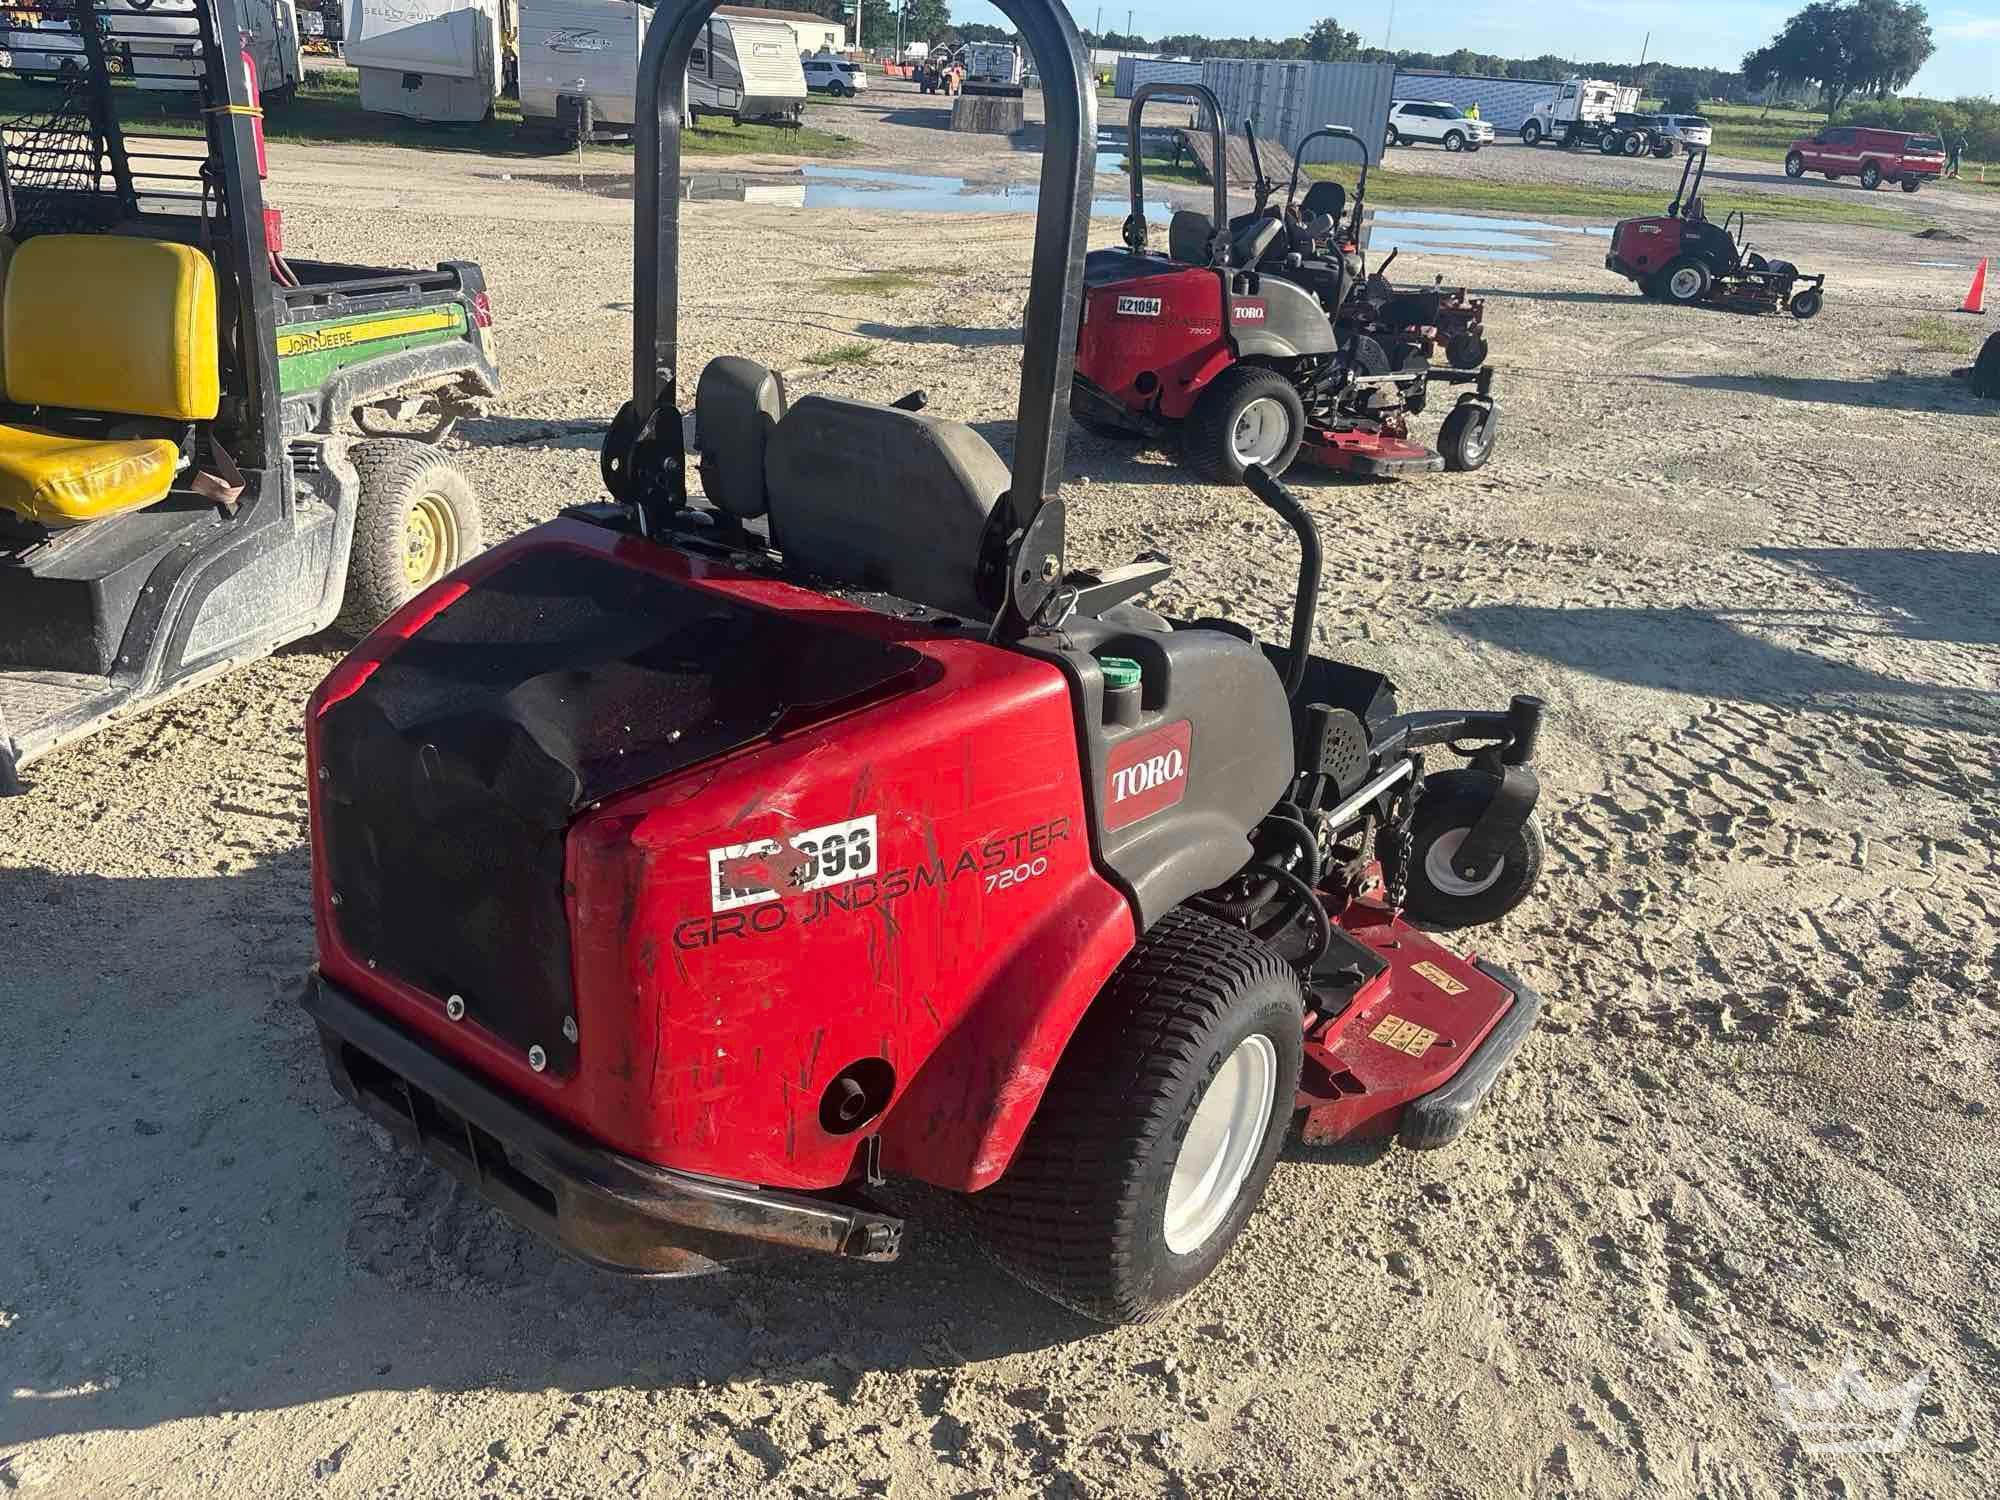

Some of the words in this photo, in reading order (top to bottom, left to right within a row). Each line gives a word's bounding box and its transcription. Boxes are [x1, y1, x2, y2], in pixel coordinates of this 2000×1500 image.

[1119, 298, 1159, 313] K21094
[1234, 307, 1264, 319] TORO
[288, 335, 318, 353] JOHN
[319, 331, 353, 348] DEERE
[1111, 749, 1184, 804] TORO
[984, 857, 1048, 896] 7200
